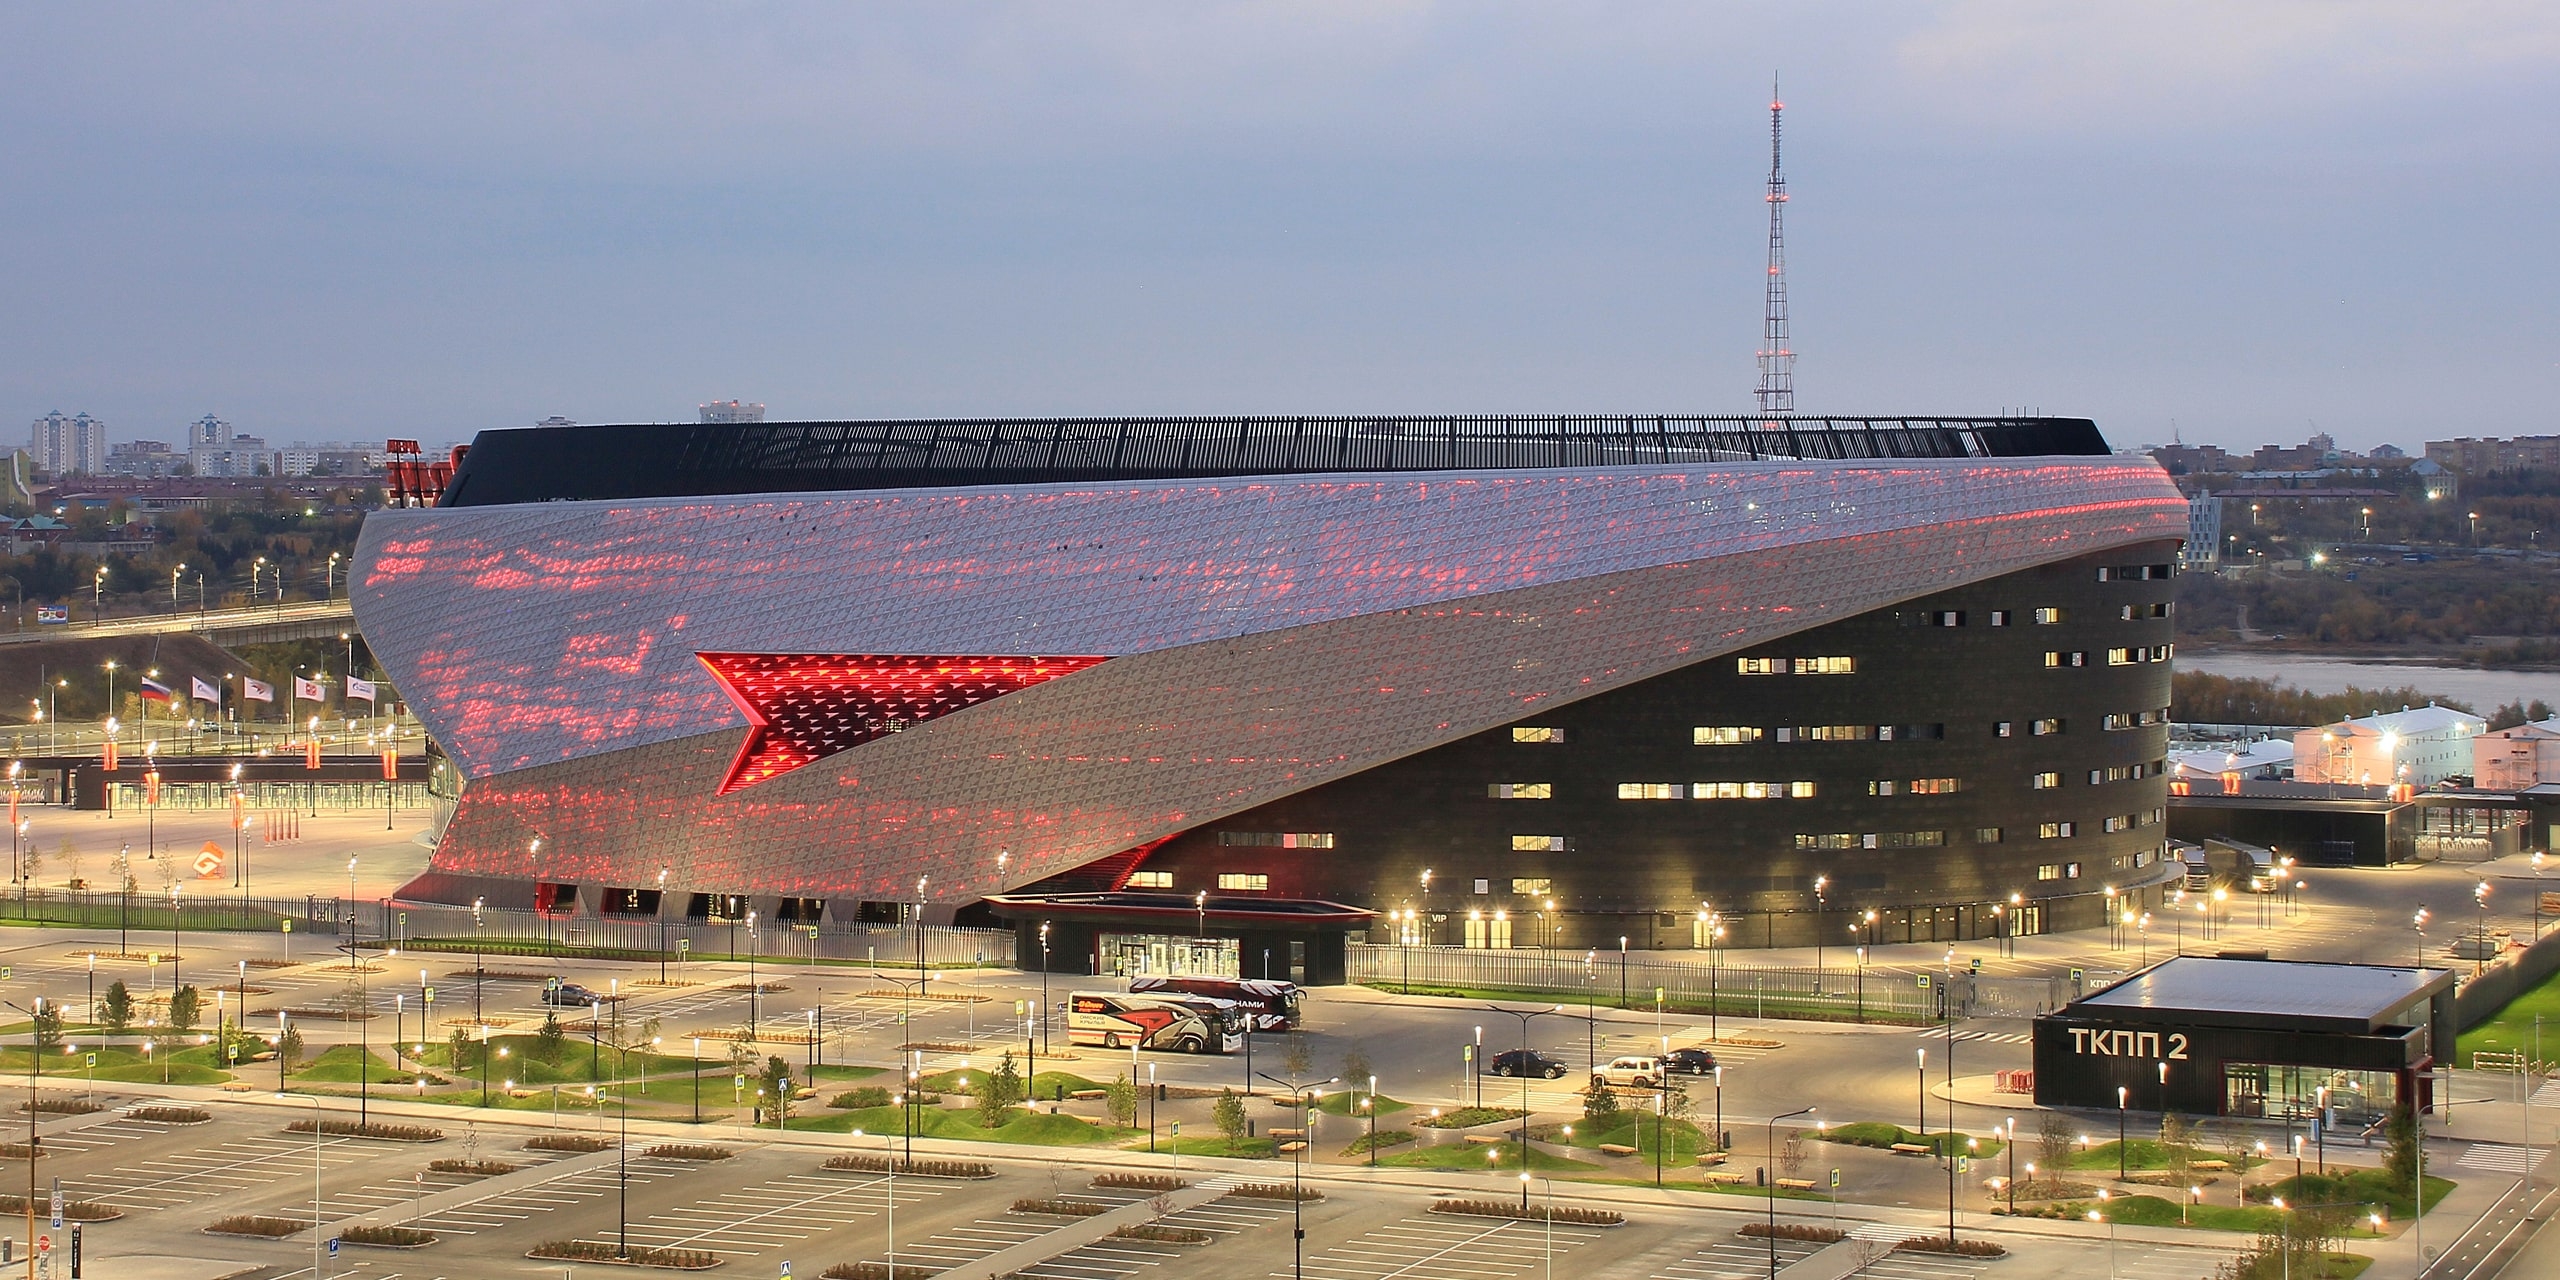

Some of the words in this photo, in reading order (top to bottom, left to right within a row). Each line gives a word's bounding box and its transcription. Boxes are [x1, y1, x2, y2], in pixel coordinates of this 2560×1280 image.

[1431, 914, 1447, 922] VIP
[1234, 1000, 1265, 1008] НАМИ
[2068, 1027, 2159, 1058] ТКПП
[2168, 1033, 2188, 1060] 2
